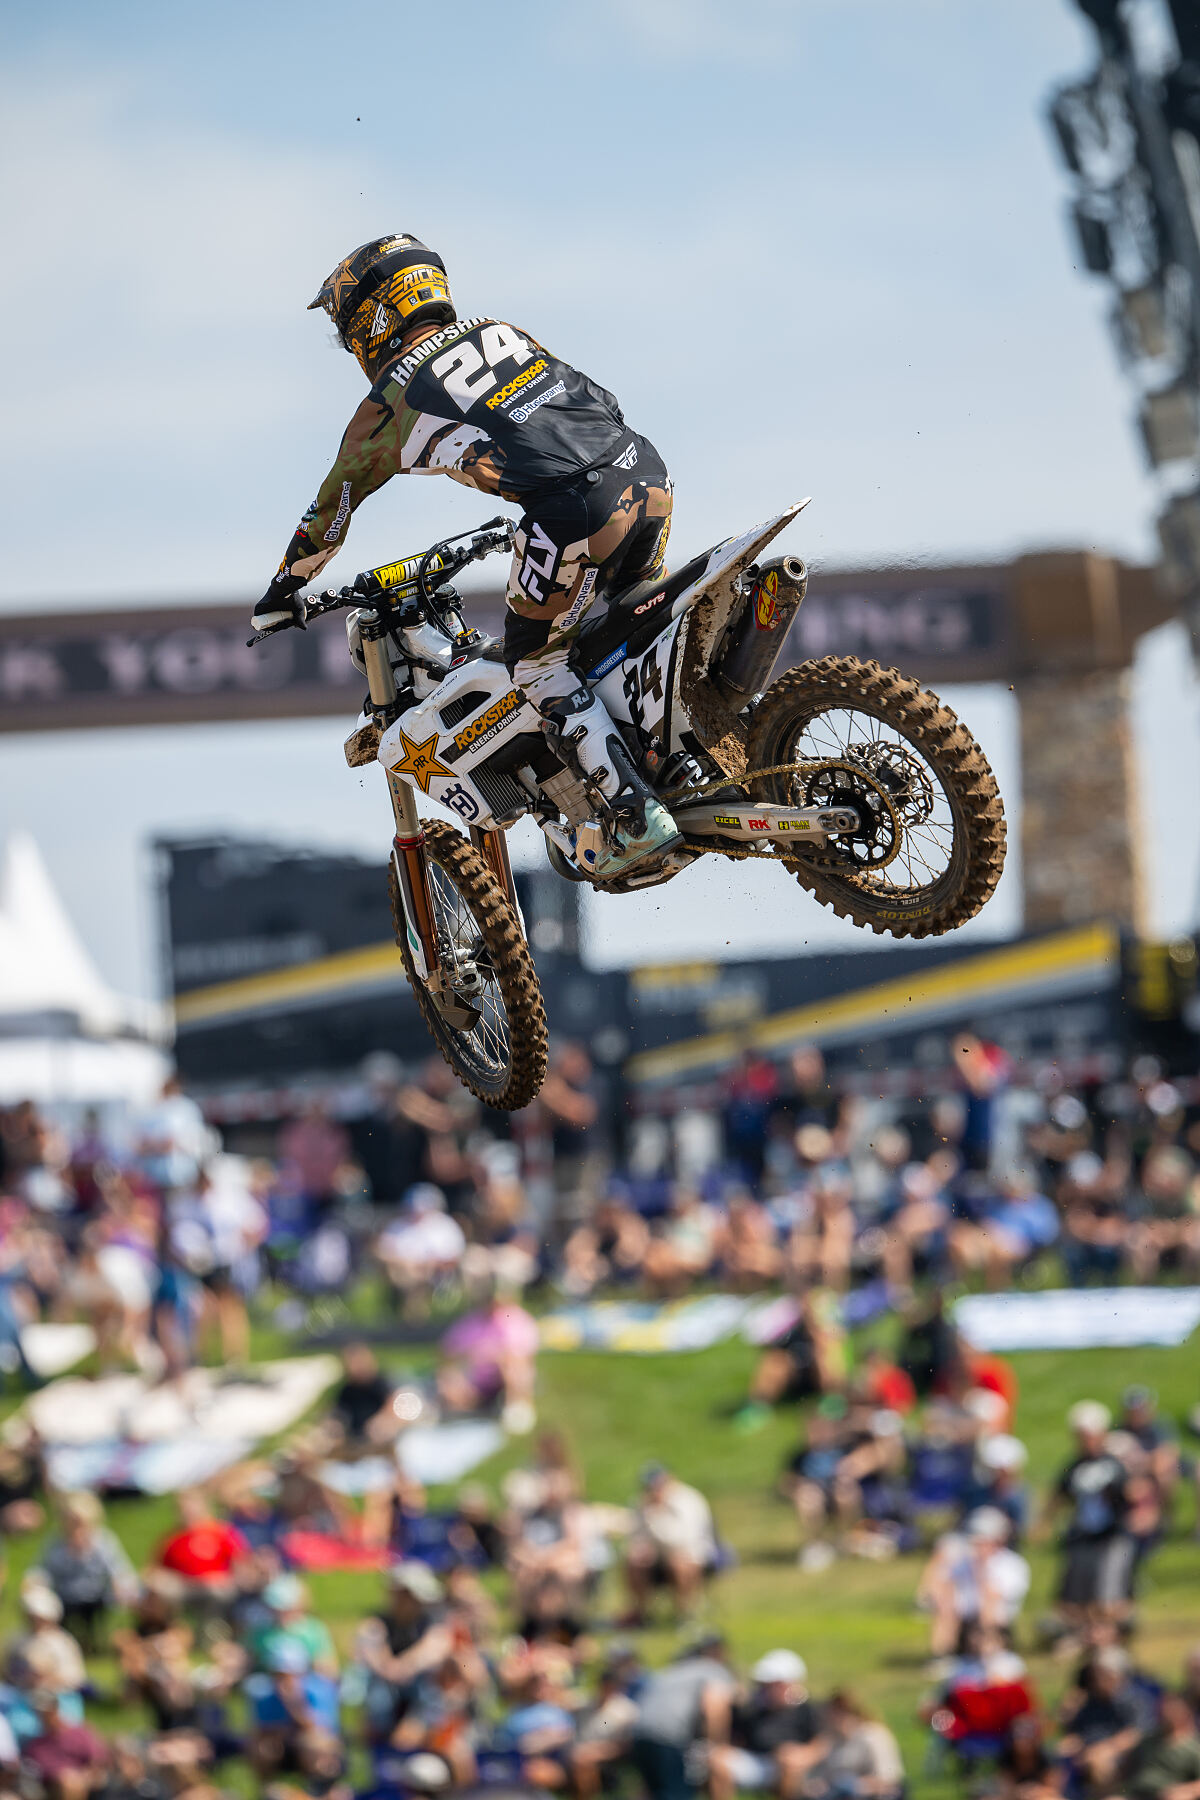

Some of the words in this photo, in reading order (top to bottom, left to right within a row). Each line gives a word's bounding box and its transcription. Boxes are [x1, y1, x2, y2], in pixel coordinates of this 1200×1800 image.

[403, 268, 438, 292] RICK
[390, 317, 500, 387] HAMPSHI
[431, 323, 534, 415] 24
[485, 359, 550, 410] ROCKSTAR
[501, 386, 528, 409] ENERGY
[527, 371, 550, 389] DRINK
[522, 382, 566, 414] Husqvarna
[332, 481, 352, 530] Husqvarna
[520, 522, 558, 602] FLY
[567, 569, 597, 620] Husqvarna
[634, 592, 666, 614] GUTS
[594, 648, 625, 677] PROGRESSIVE
[570, 689, 590, 709] RJ
[454, 690, 520, 751] ROCKSTAR
[469, 728, 498, 753] ENERGY
[497, 708, 521, 730] DRINK
[714, 816, 740, 825] EXCEL
[748, 819, 770, 830] RK
[876, 905, 931, 920] DUNLOP
